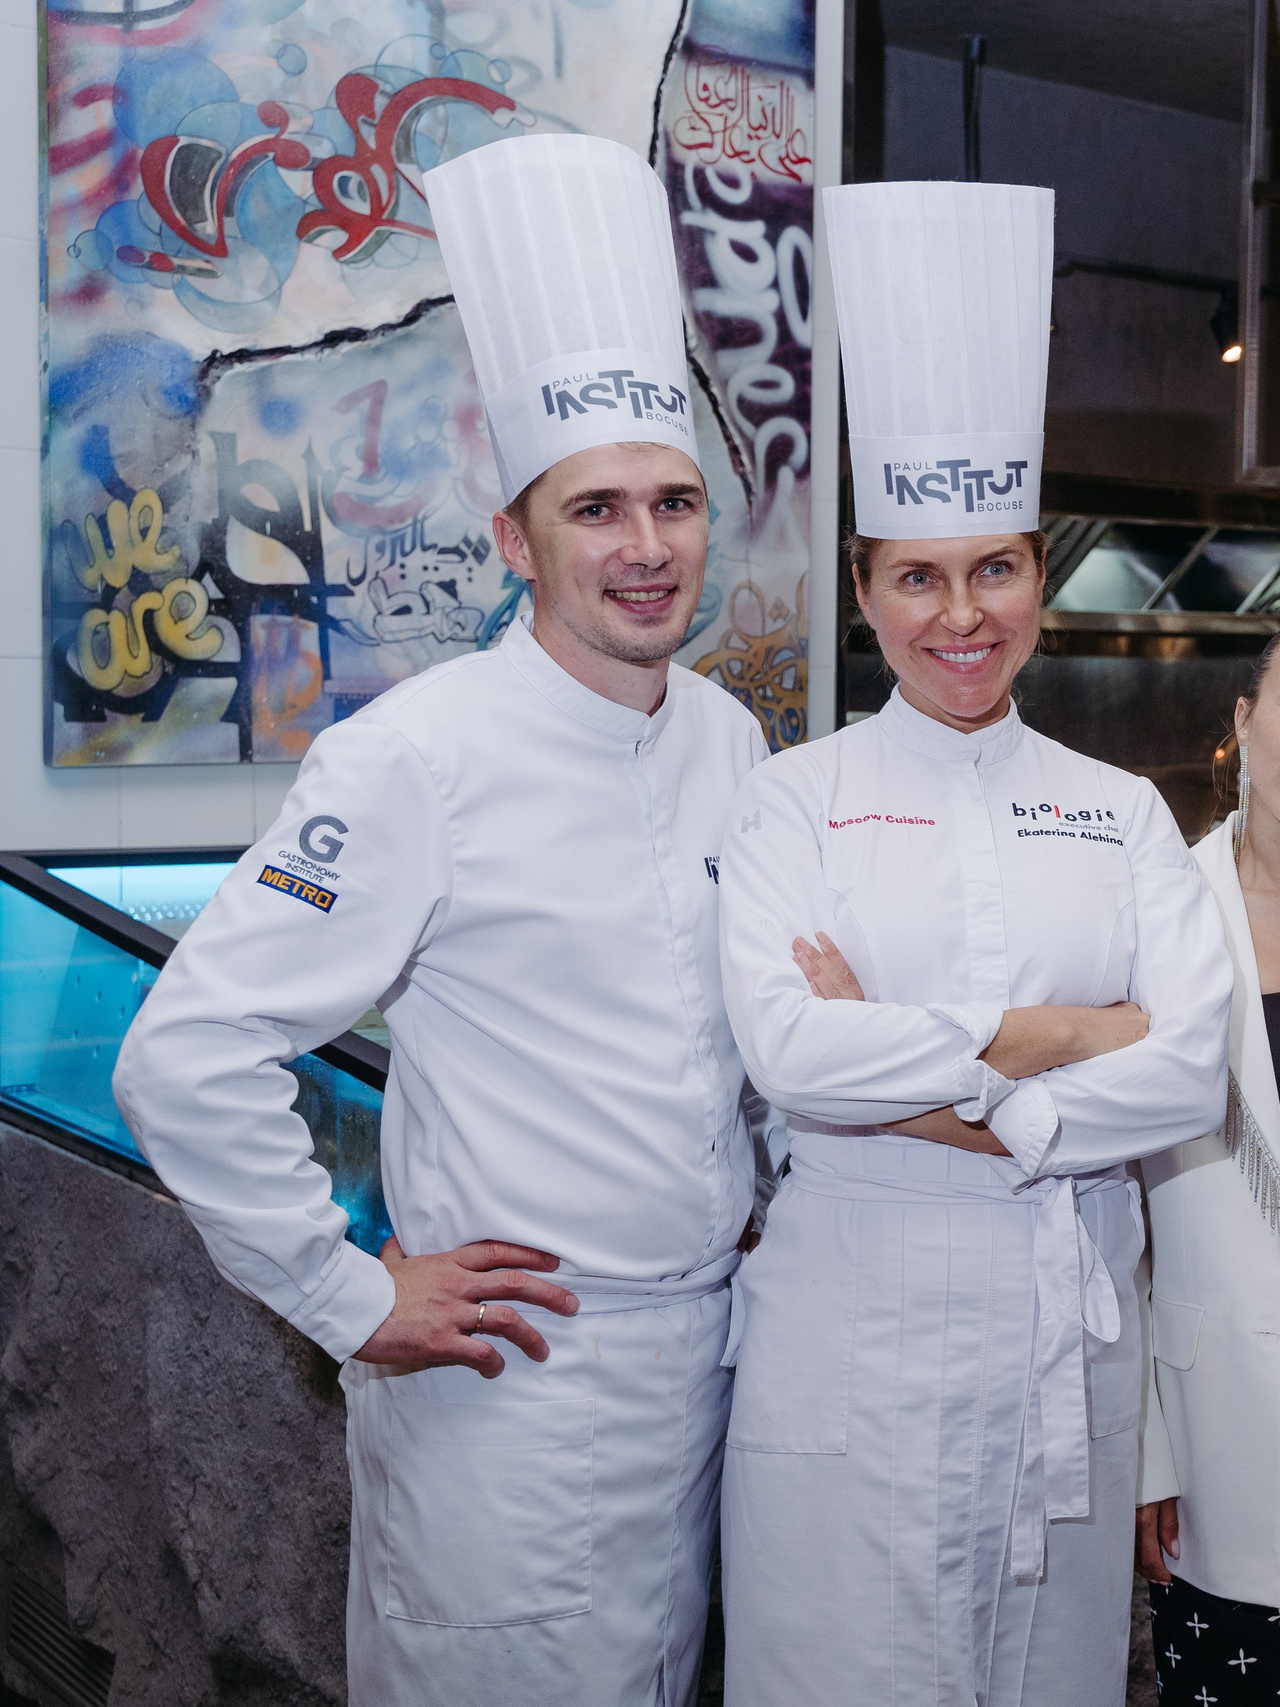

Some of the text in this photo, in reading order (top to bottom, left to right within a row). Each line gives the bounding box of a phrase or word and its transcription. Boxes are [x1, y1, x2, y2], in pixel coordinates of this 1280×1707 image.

[552, 373, 594, 390] PAUL
[541, 369, 687, 422] INSTITUT
[646, 411, 689, 437] BOCUSE
[894, 461, 933, 472] PAUL
[883, 458, 1028, 513] INSTITUT
[977, 500, 1024, 513] BOCUSE
[828, 814, 936, 830] Moscow Cuisine
[1017, 828, 1124, 847] Ekaterina Alehina
[278, 850, 341, 882] GASTRONOMY
[284, 862, 325, 884] INSTITUTE
[260, 867, 333, 909] METRO
